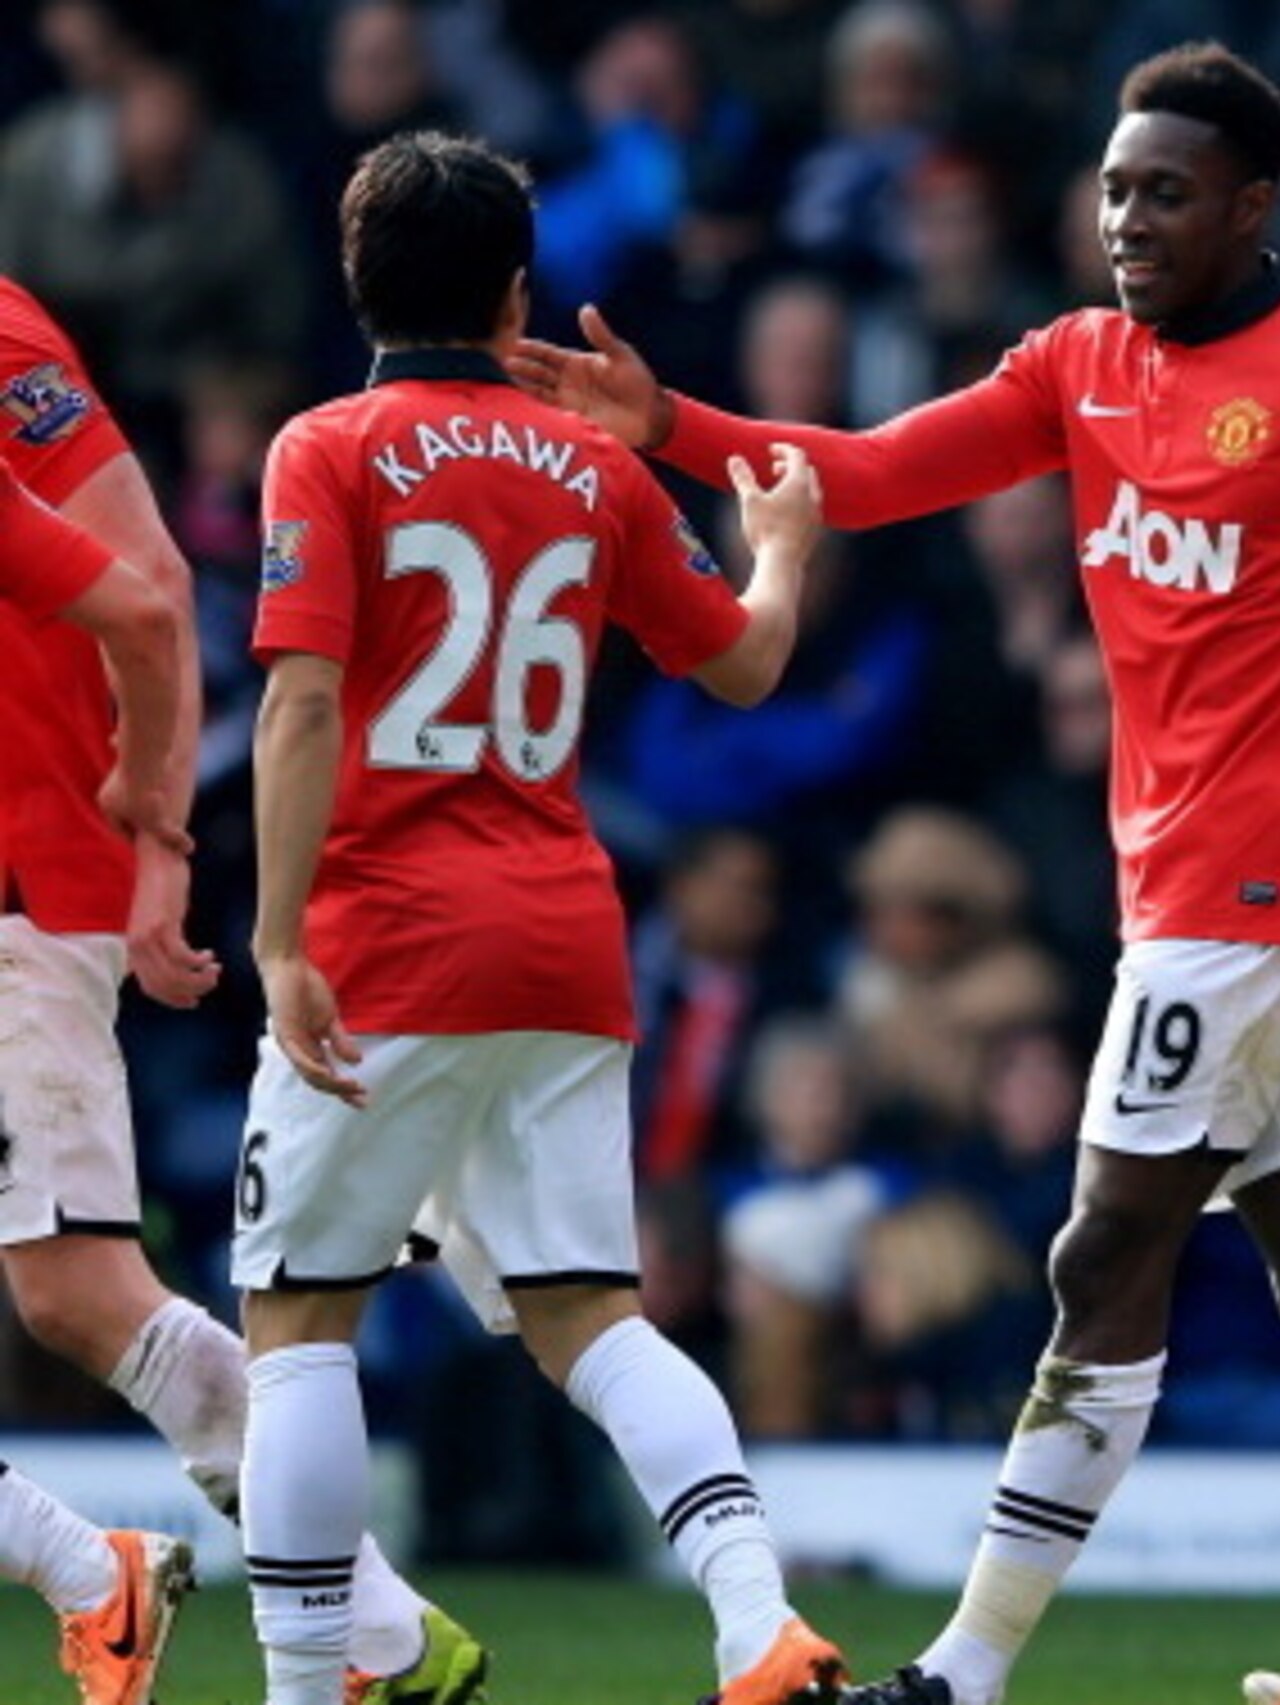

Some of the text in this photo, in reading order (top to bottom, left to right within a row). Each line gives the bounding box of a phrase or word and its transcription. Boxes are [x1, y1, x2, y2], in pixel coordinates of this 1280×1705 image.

[374, 415, 599, 512] KAGAWA
[366, 520, 596, 782] 26
[1121, 993, 1201, 1093] 19
